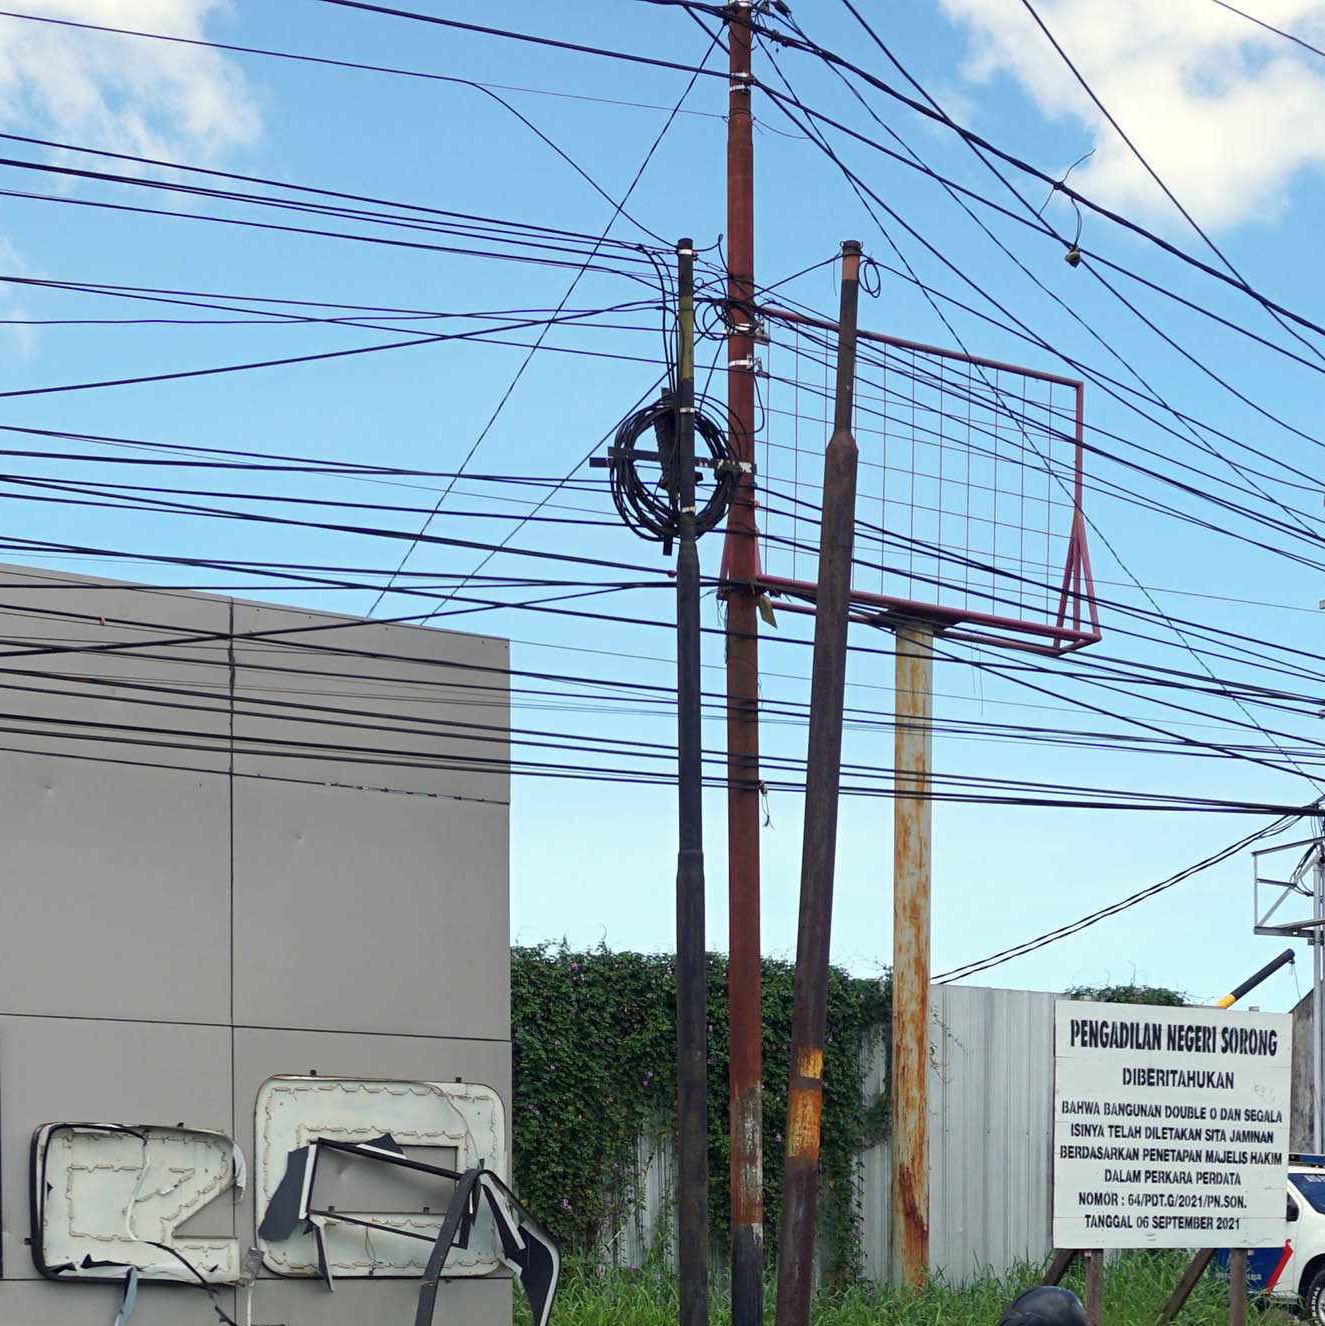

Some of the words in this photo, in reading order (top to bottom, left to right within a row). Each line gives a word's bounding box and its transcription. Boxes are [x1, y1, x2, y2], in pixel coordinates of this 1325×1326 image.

[1070, 1019, 1163, 1051] PENGADILAN
[1166, 1023, 1217, 1054] NEGERI
[1220, 1026, 1278, 1057] SORONG
[1122, 1067, 1235, 1090] DIBERITAHUKAN
[1061, 1100, 1101, 1116] BAHWA
[1103, 1102, 1162, 1118] BANGUNAN
[1164, 1105, 1207, 1120] DOUBLE
[1219, 1107, 1242, 1122] DAN
[1243, 1108, 1283, 1124] SEGALA
[1070, 1122, 1105, 1138] ISINYA
[1107, 1124, 1142, 1139] TELAH
[1144, 1126, 1203, 1141] DILETAKAN
[1204, 1128, 1227, 1143] SITA
[1229, 1129, 1274, 1144] JAMINAN
[1059, 1144, 1140, 1161] BERDASARKAN
[1142, 1147, 1203, 1163] PENETAPAN
[1204, 1149, 1249, 1165] MAJELIS
[1249, 1151, 1283, 1166] HAKIM
[1104, 1168, 1142, 1183] DALAM
[1144, 1169, 1193, 1185] PERKARA
[1195, 1171, 1242, 1186] PERDATA
[1078, 1191, 1119, 1207] NOMOR
[1084, 1214, 1134, 1229] TANGGAL
[1136, 1215, 1150, 1229] 06
[1151, 1215, 1214, 1230] SEPTEMBER
[1216, 1216, 1240, 1231] 2021
